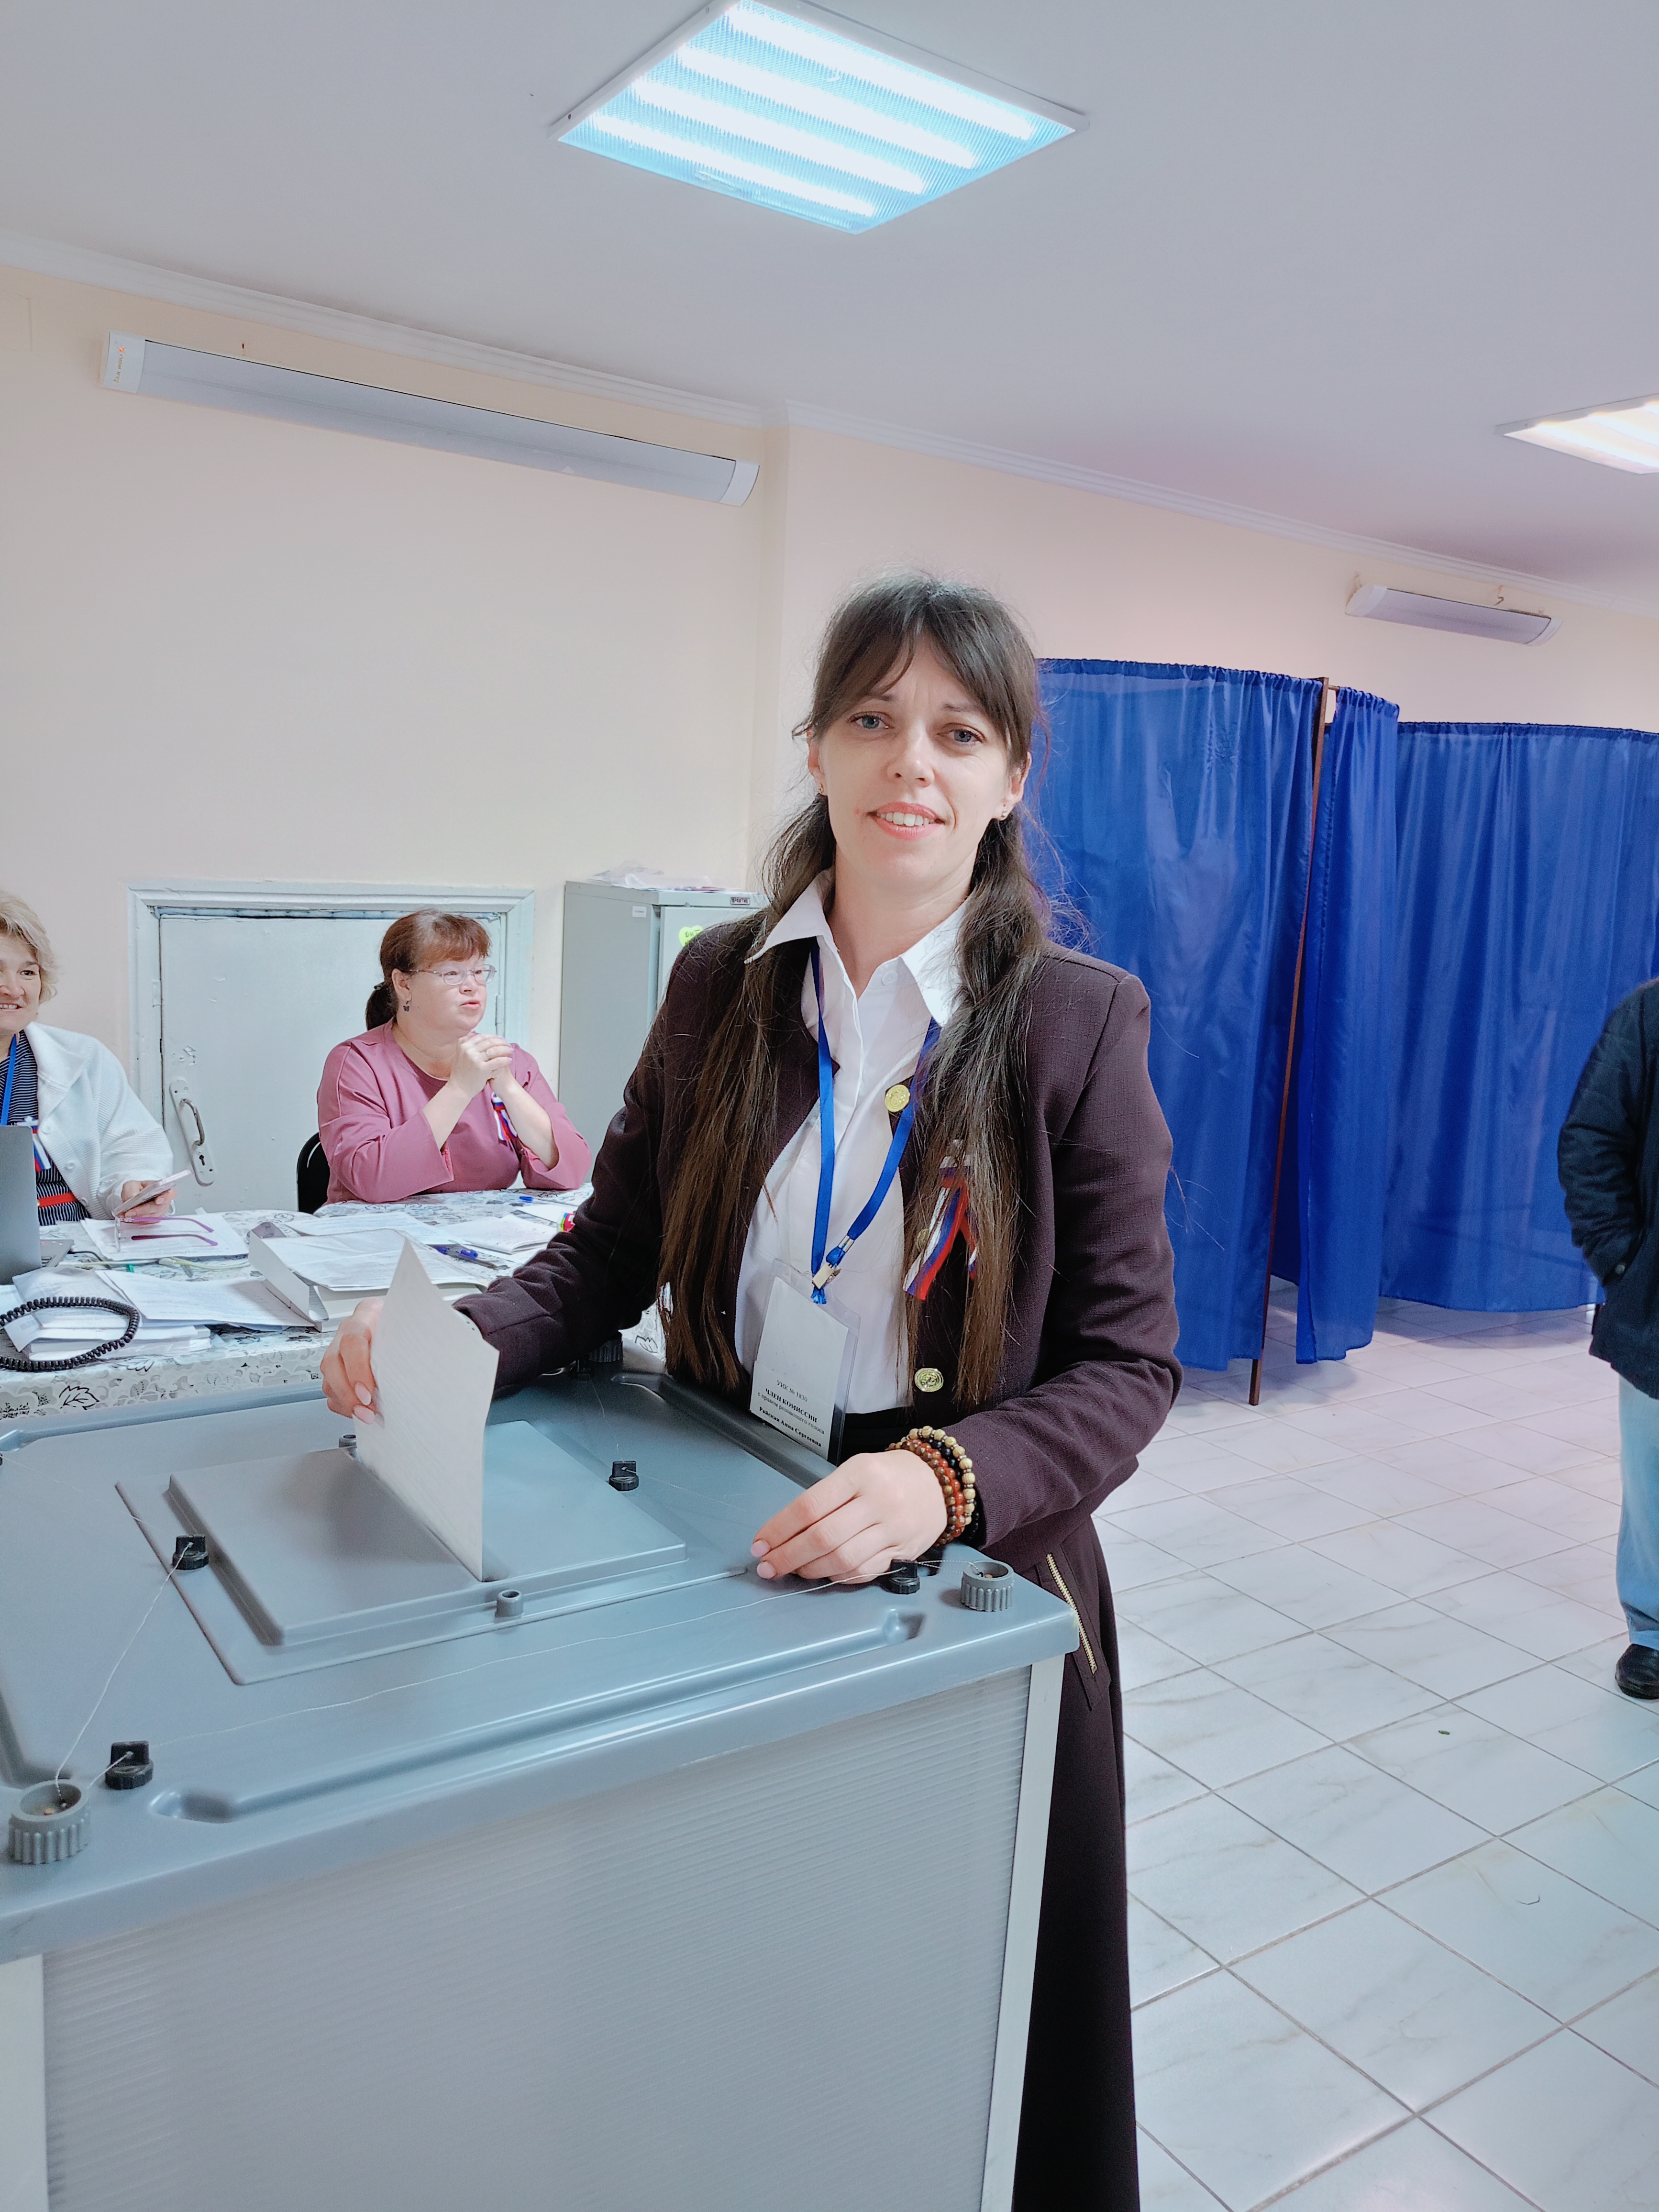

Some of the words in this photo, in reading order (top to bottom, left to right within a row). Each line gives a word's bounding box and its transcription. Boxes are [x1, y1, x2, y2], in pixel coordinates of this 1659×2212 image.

[765, 1388, 781, 1401] ЧЛЕН
[783, 1398, 817, 1423] КОМИССИИ
[777, 1380, 788, 1391] УИК
[796, 1392, 807, 1402] 1830
[759, 1406, 780, 1422] Райская
[781, 1420, 794, 1431] Анна
[795, 1428, 822, 1447] Сергеевна
[762, 1394, 778, 1407] правом
[779, 1405, 807, 1425] решающего
[808, 1423, 824, 1435] голоса
